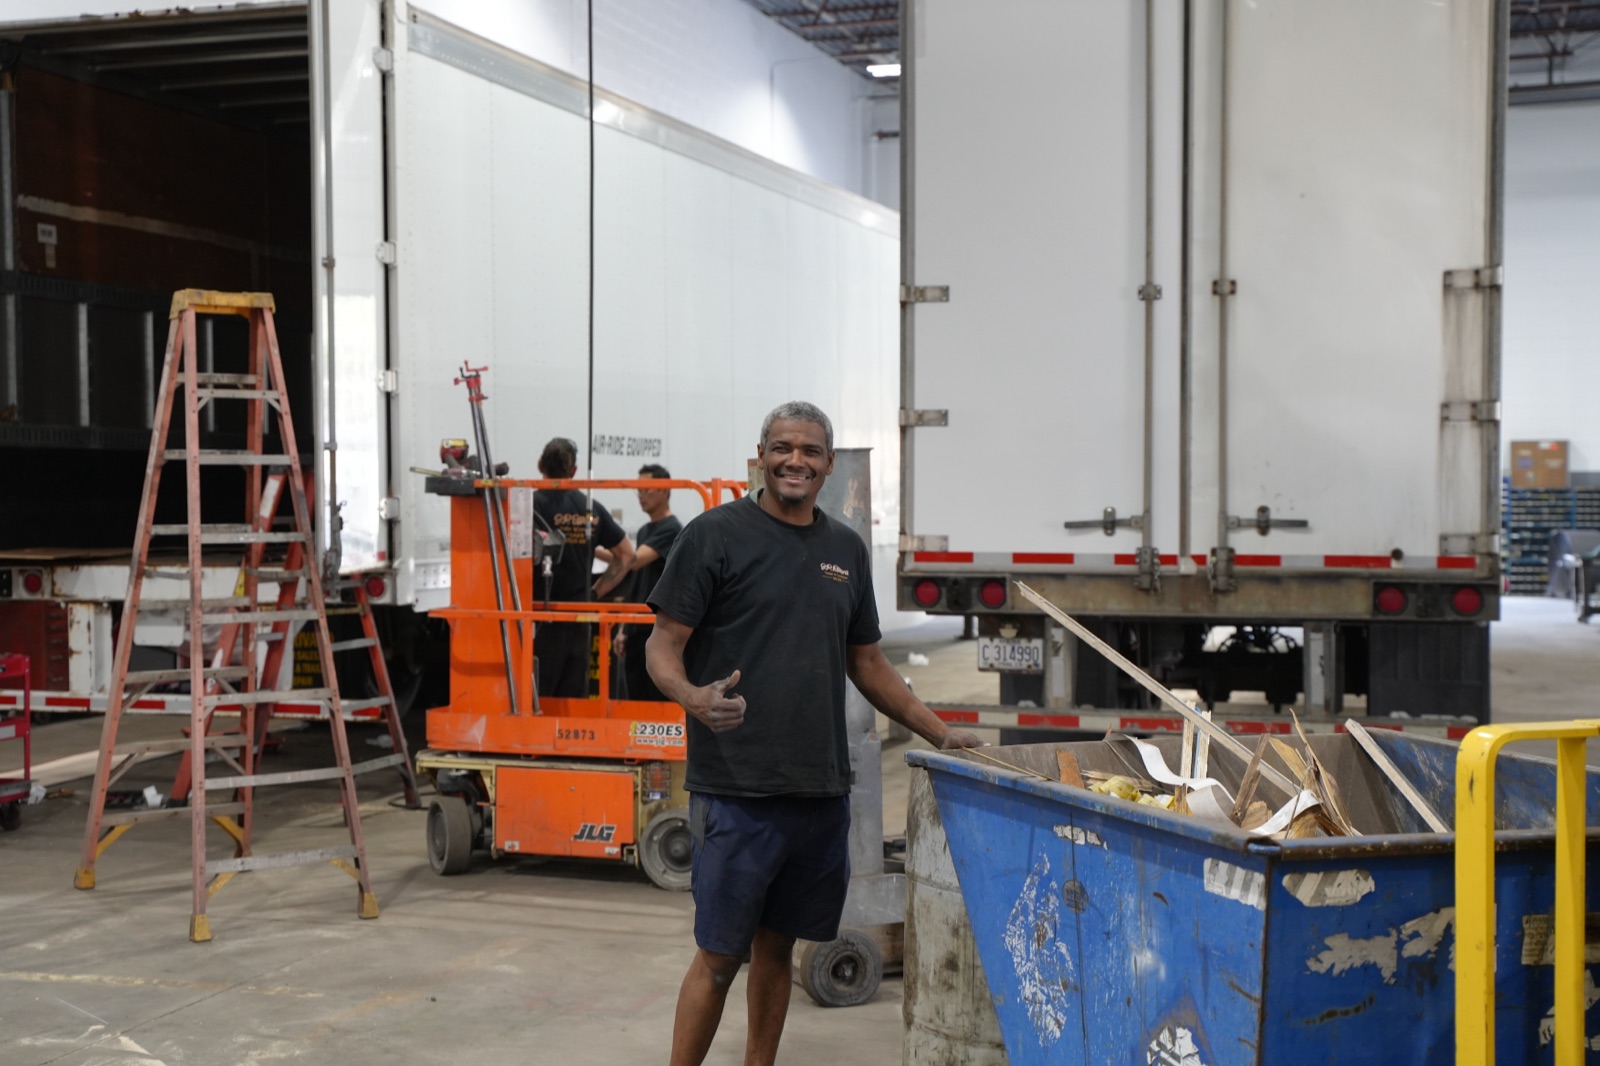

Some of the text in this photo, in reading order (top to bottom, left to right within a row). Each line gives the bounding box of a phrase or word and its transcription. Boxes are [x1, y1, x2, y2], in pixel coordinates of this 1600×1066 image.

[592, 434, 662, 457] AIR-RIDE EQUIPPED
[994, 645, 1039, 662] 314990
[557, 729, 595, 741] 52873
[573, 824, 616, 842] JLG
